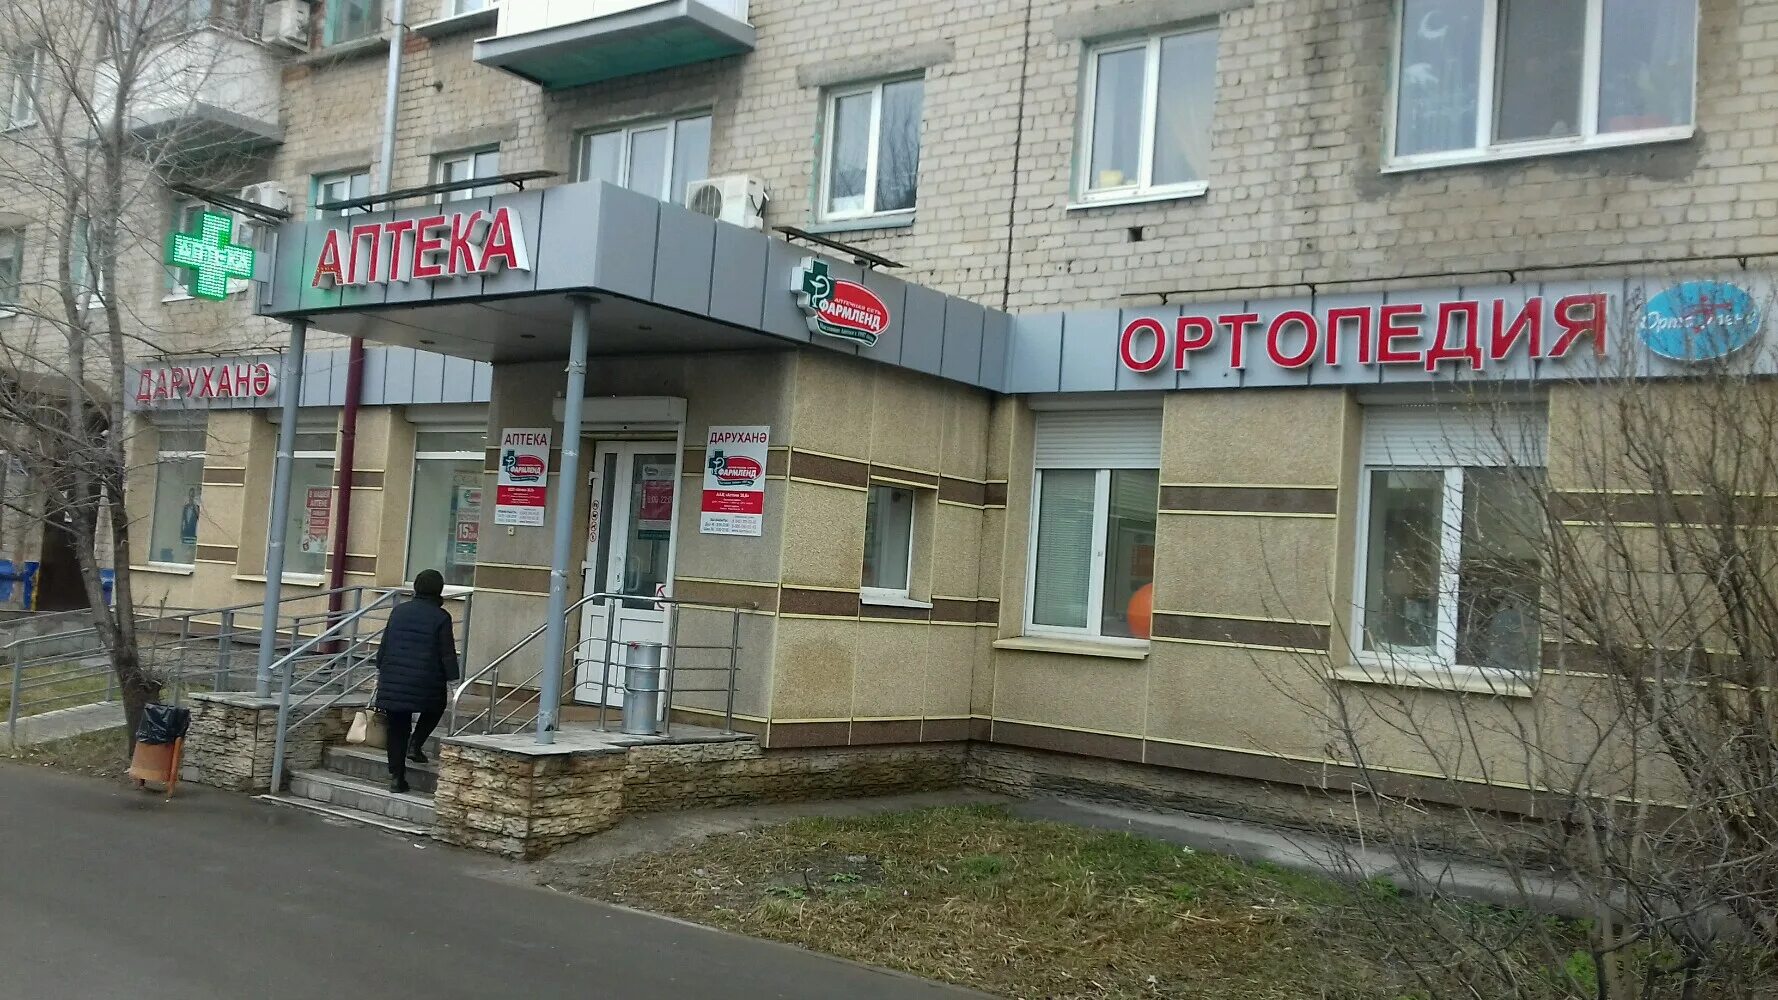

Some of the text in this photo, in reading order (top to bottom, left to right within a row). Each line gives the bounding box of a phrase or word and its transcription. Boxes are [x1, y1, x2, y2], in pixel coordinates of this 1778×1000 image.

[311, 206, 520, 288] АПТЕКА
[819, 299, 881, 330] ФАРМЛЕНД
[1118, 292, 1608, 374] ОРТОПЕДИЯ
[135, 362, 272, 406] ДАРУХАНӘ
[504, 433, 548, 446] АПТЕКА
[710, 432, 767, 444] ДАРУХАНӘ
[718, 468, 757, 479] ФАРМЛЕНД
